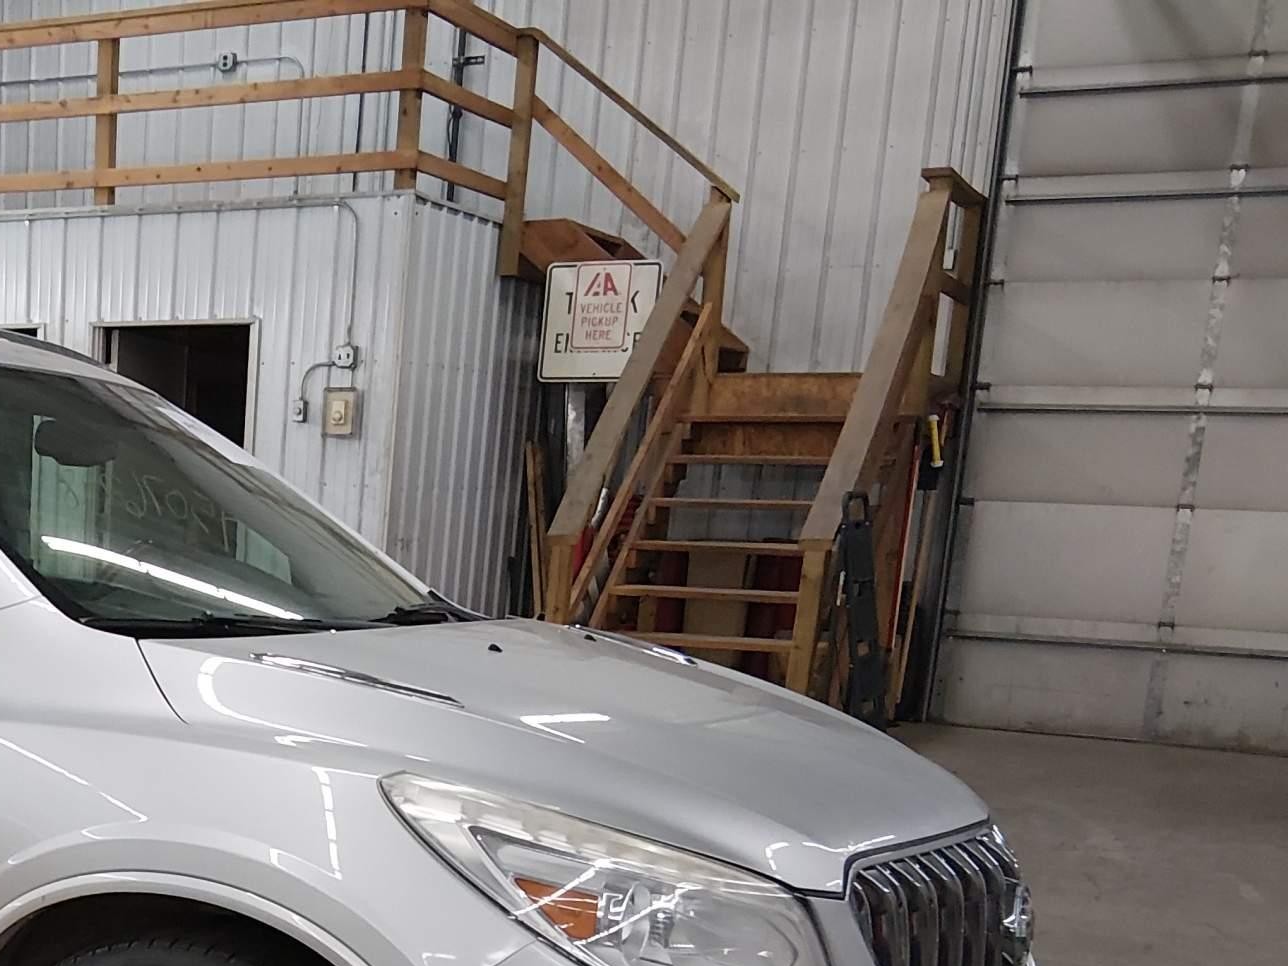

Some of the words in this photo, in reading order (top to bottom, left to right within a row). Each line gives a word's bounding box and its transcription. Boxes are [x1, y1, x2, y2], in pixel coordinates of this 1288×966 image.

[580, 302, 623, 314] VEHICLE
[580, 316, 619, 327] PICKUP
[584, 329, 612, 341] HERE
